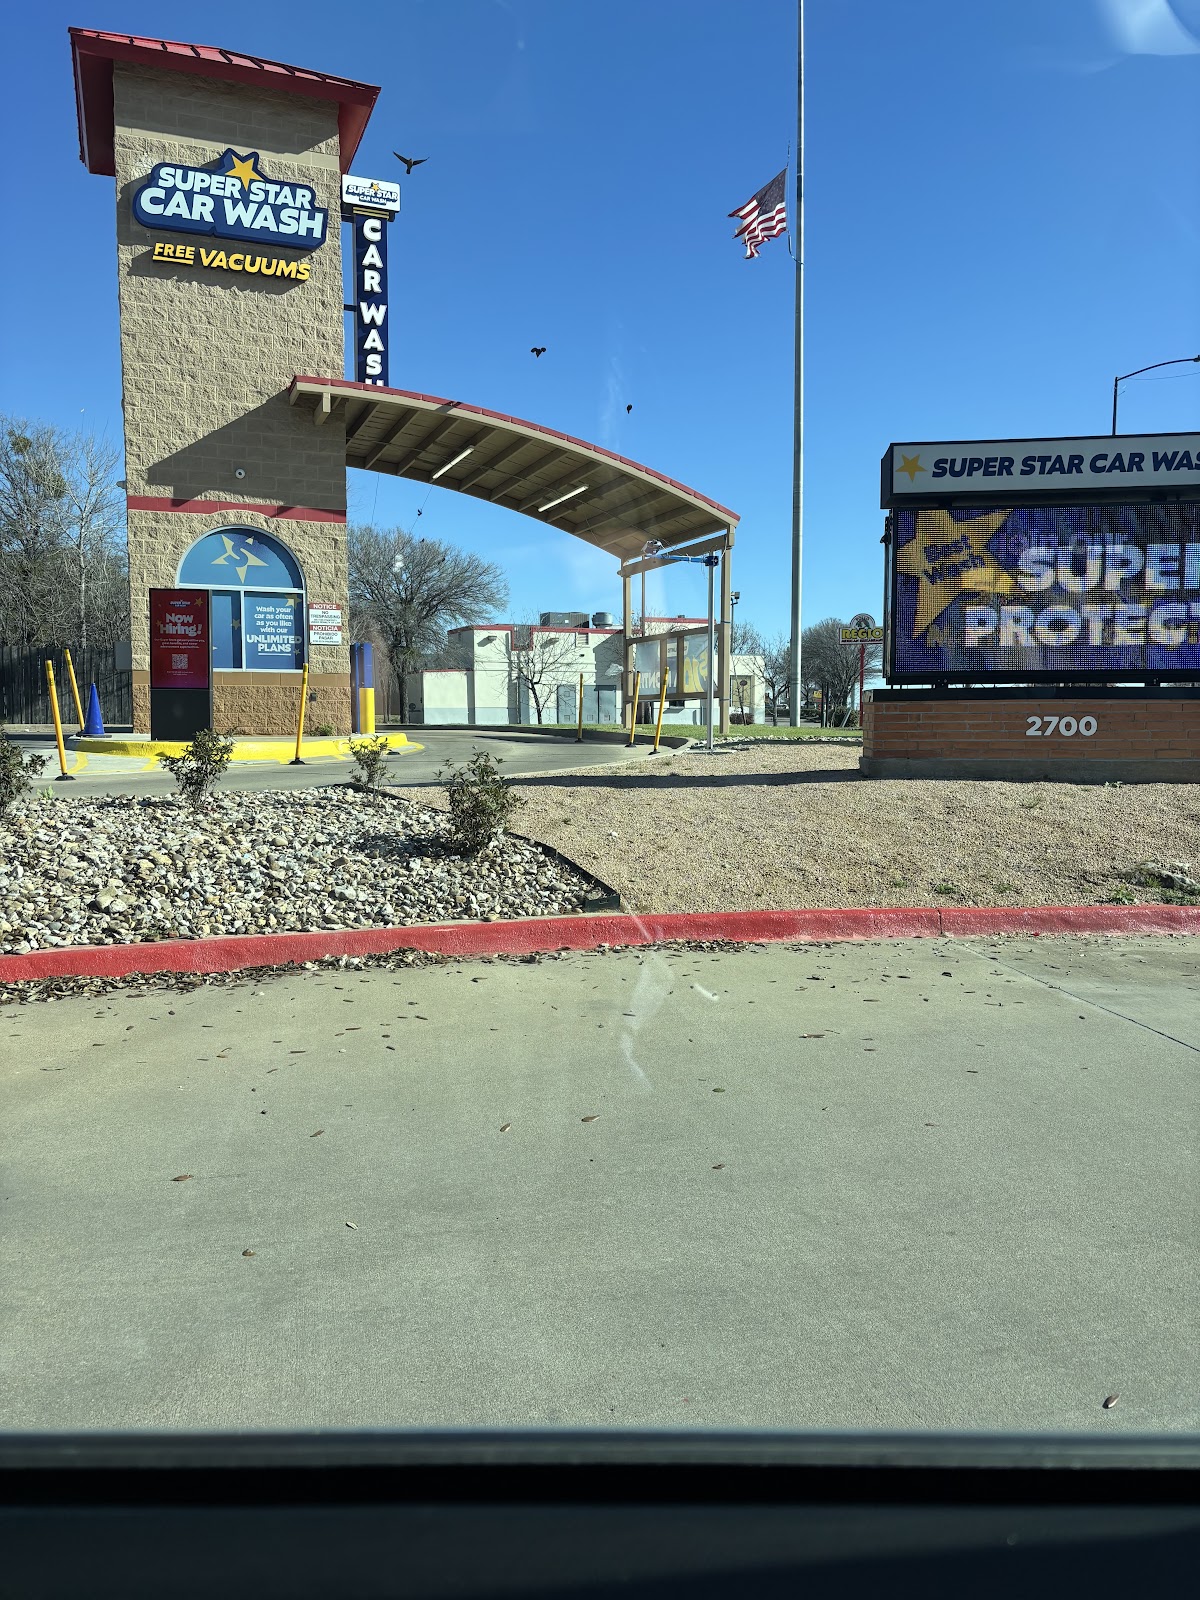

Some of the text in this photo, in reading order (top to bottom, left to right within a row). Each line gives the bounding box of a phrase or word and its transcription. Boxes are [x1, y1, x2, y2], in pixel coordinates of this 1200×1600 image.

[158, 167, 313, 210] SUPER STAR
[348, 185, 398, 202] SUPER STAR
[140, 188, 325, 239] CAR WASH
[153, 242, 311, 281] FREE VACUUMS
[362, 218, 384, 293] CAR
[932, 457, 1014, 478] SUPER
[1020, 455, 1084, 475] STAR
[1089, 452, 1145, 473] CAR
[165, 612, 194, 623] Now
[160, 623, 203, 637] Hiring!
[247, 634, 302, 644] UNLIMITED
[841, 628, 883, 640] REGIO
[258, 643, 291, 652] PLANS
[1025, 715, 1098, 736] 2700
